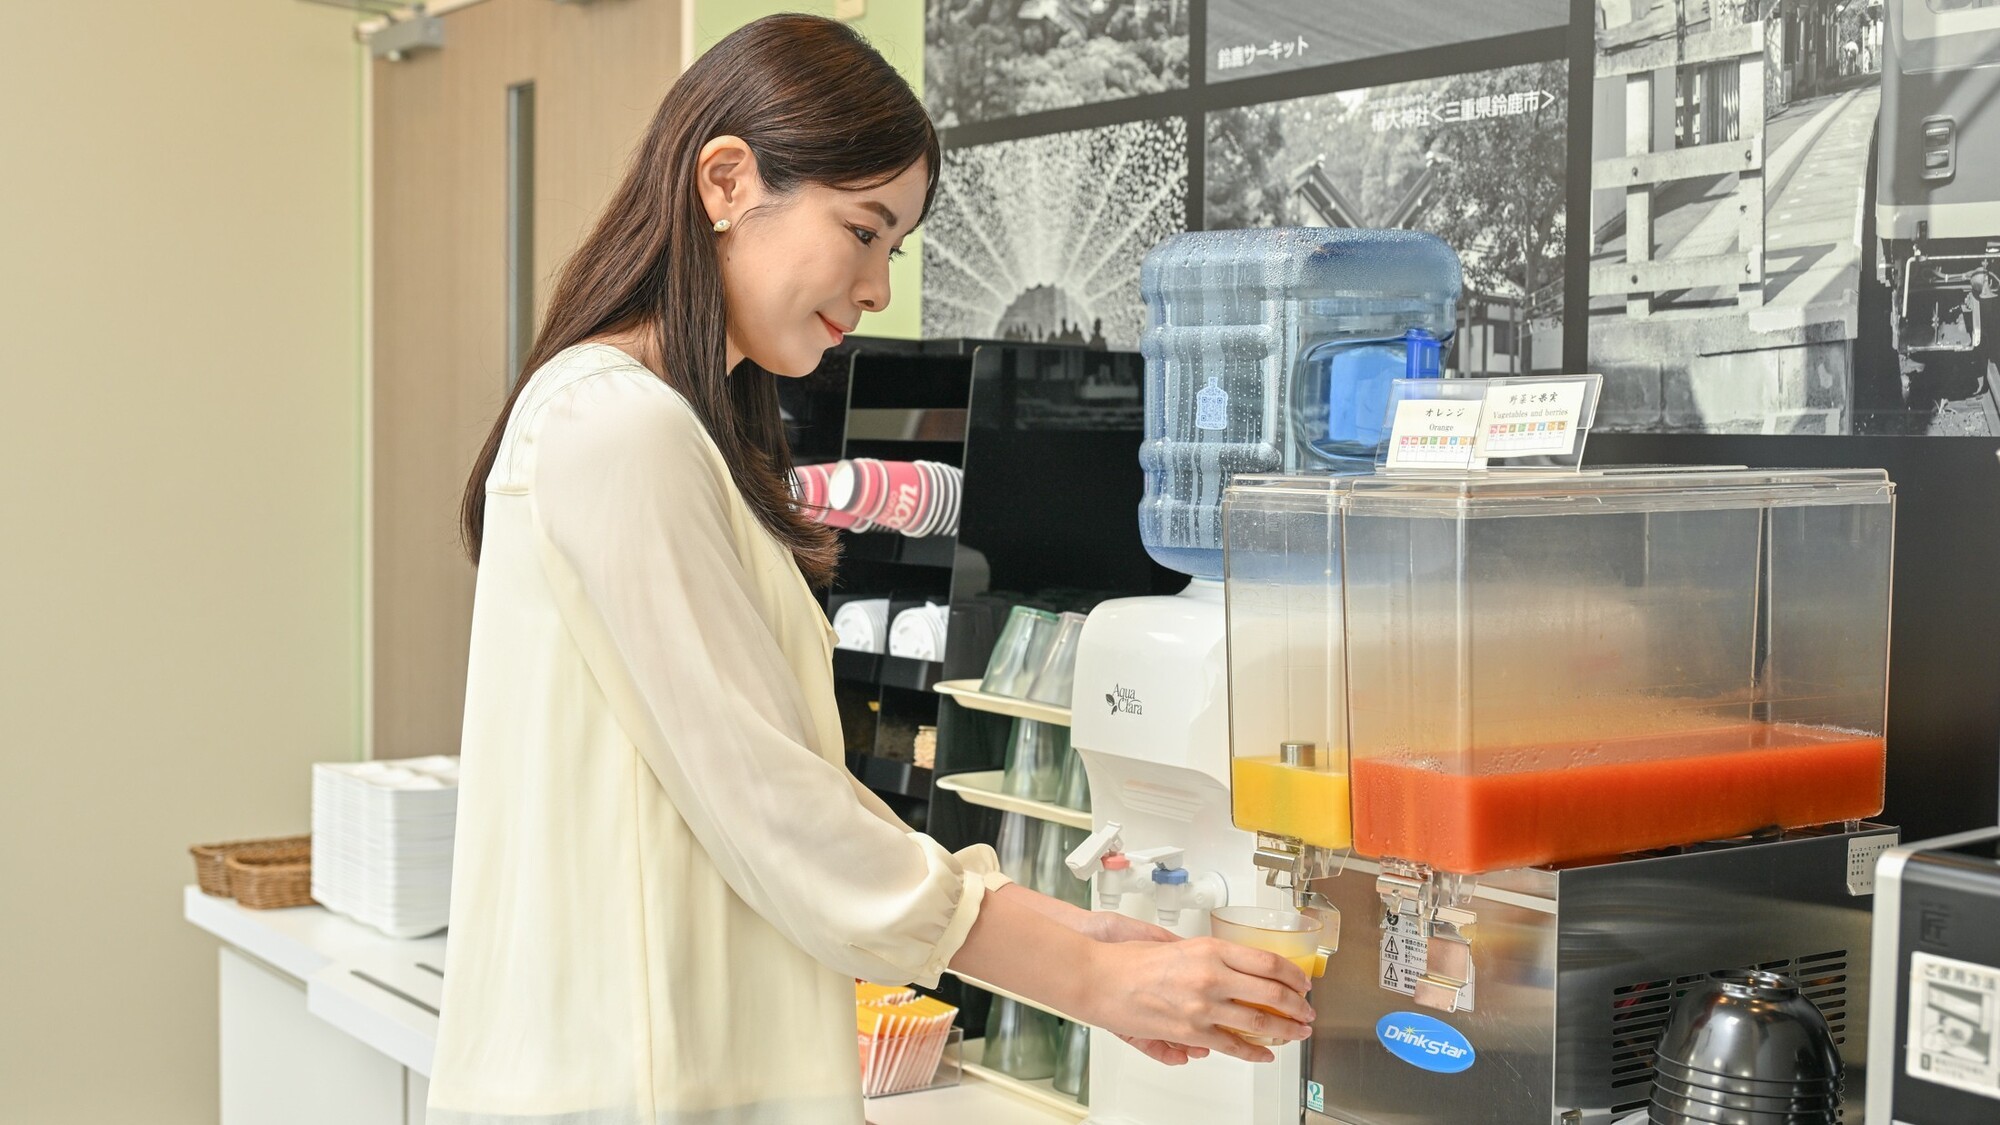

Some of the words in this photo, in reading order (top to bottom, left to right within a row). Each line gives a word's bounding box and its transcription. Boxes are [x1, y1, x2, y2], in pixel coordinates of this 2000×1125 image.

[1218, 35, 1309, 70] 鈴鹿サーキット
[1425, 408, 1465, 417] オレンジ
[1530, 408, 1544, 417] and
[1545, 407, 1569, 417] berries
[1429, 423, 1454, 432] Orange
[1113, 683, 1136, 701] Aqua
[1117, 697, 1143, 716] Clara
